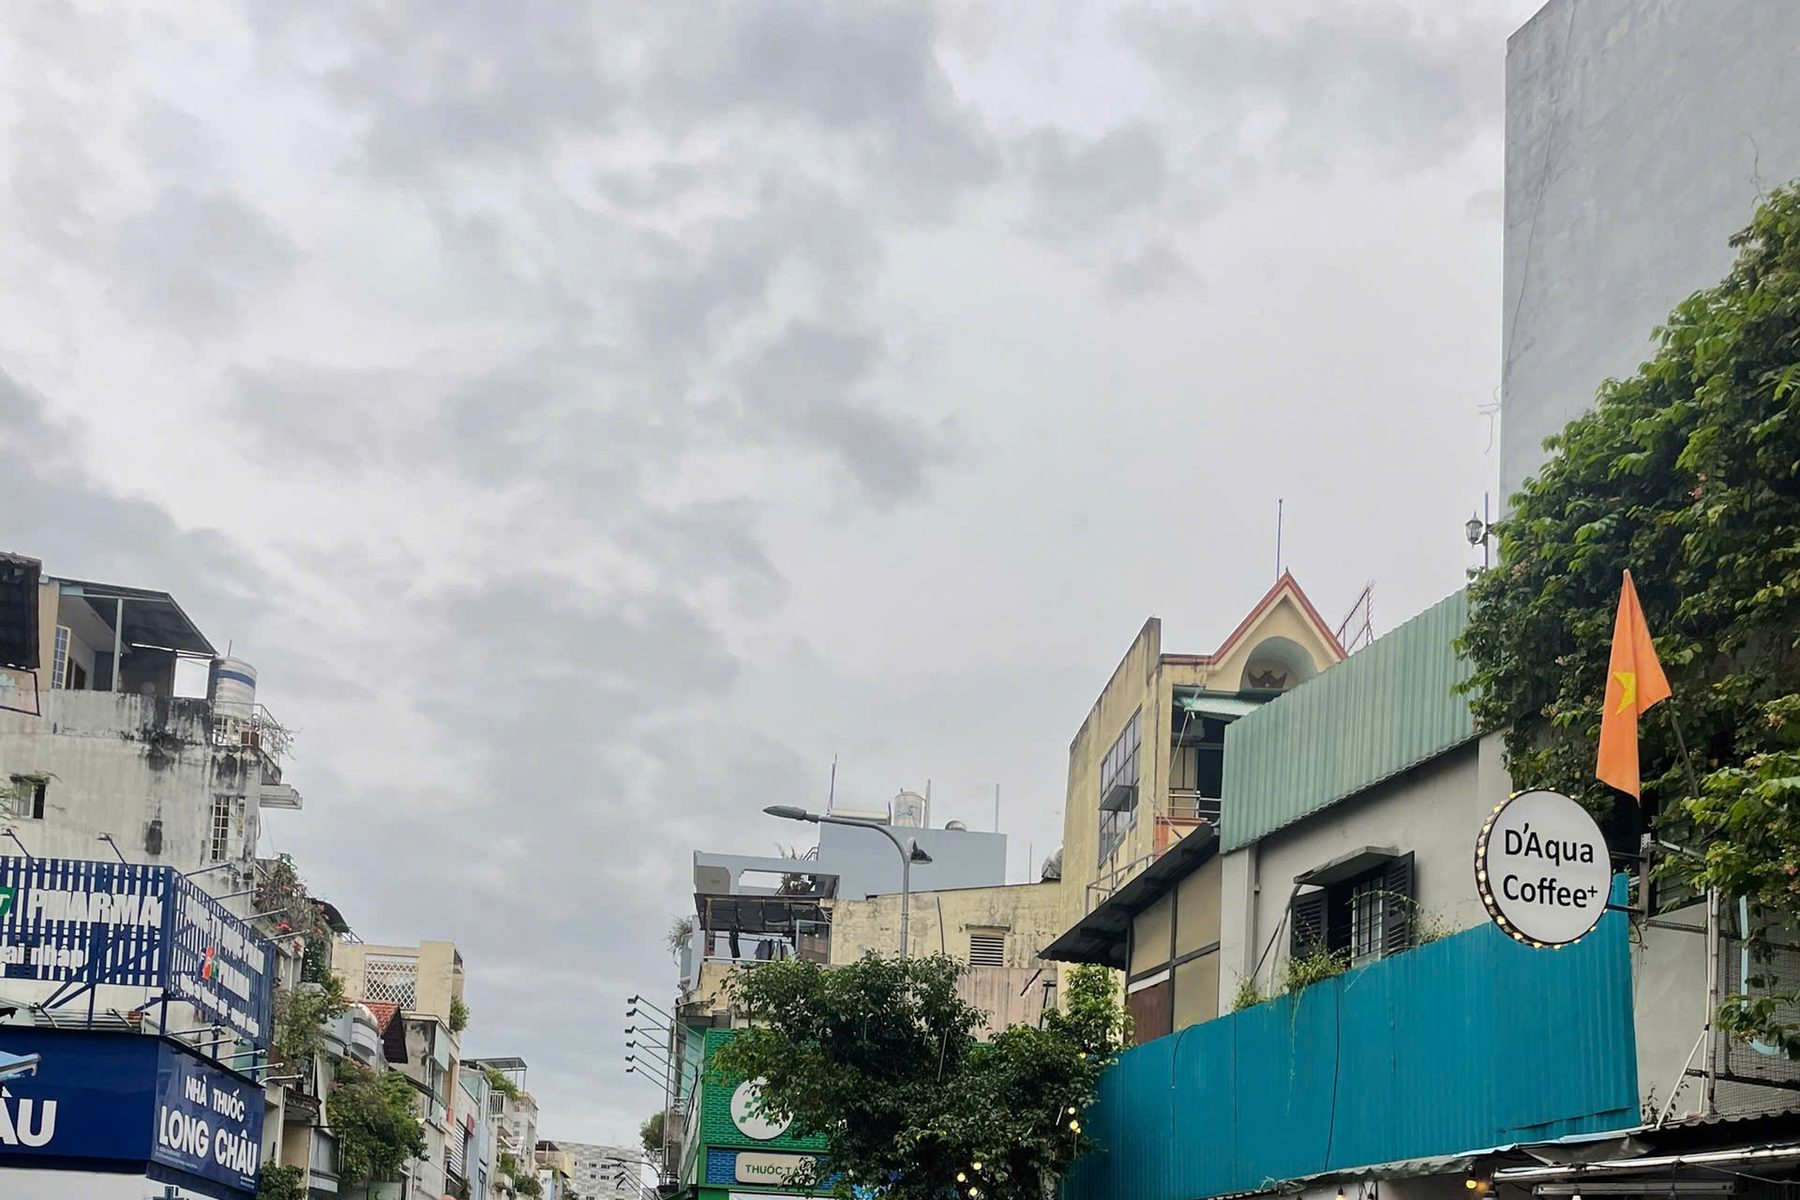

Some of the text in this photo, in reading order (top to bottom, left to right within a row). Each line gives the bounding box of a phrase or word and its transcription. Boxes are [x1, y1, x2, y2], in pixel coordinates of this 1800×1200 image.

[1504, 822, 1594, 867] D'Aqua
[185, 1075, 245, 1122] NHÀ THUỐC
[159, 1105, 209, 1158] LONG
[214, 1129, 258, 1176] CHÂU
[745, 1163, 783, 1176] THUỐC
